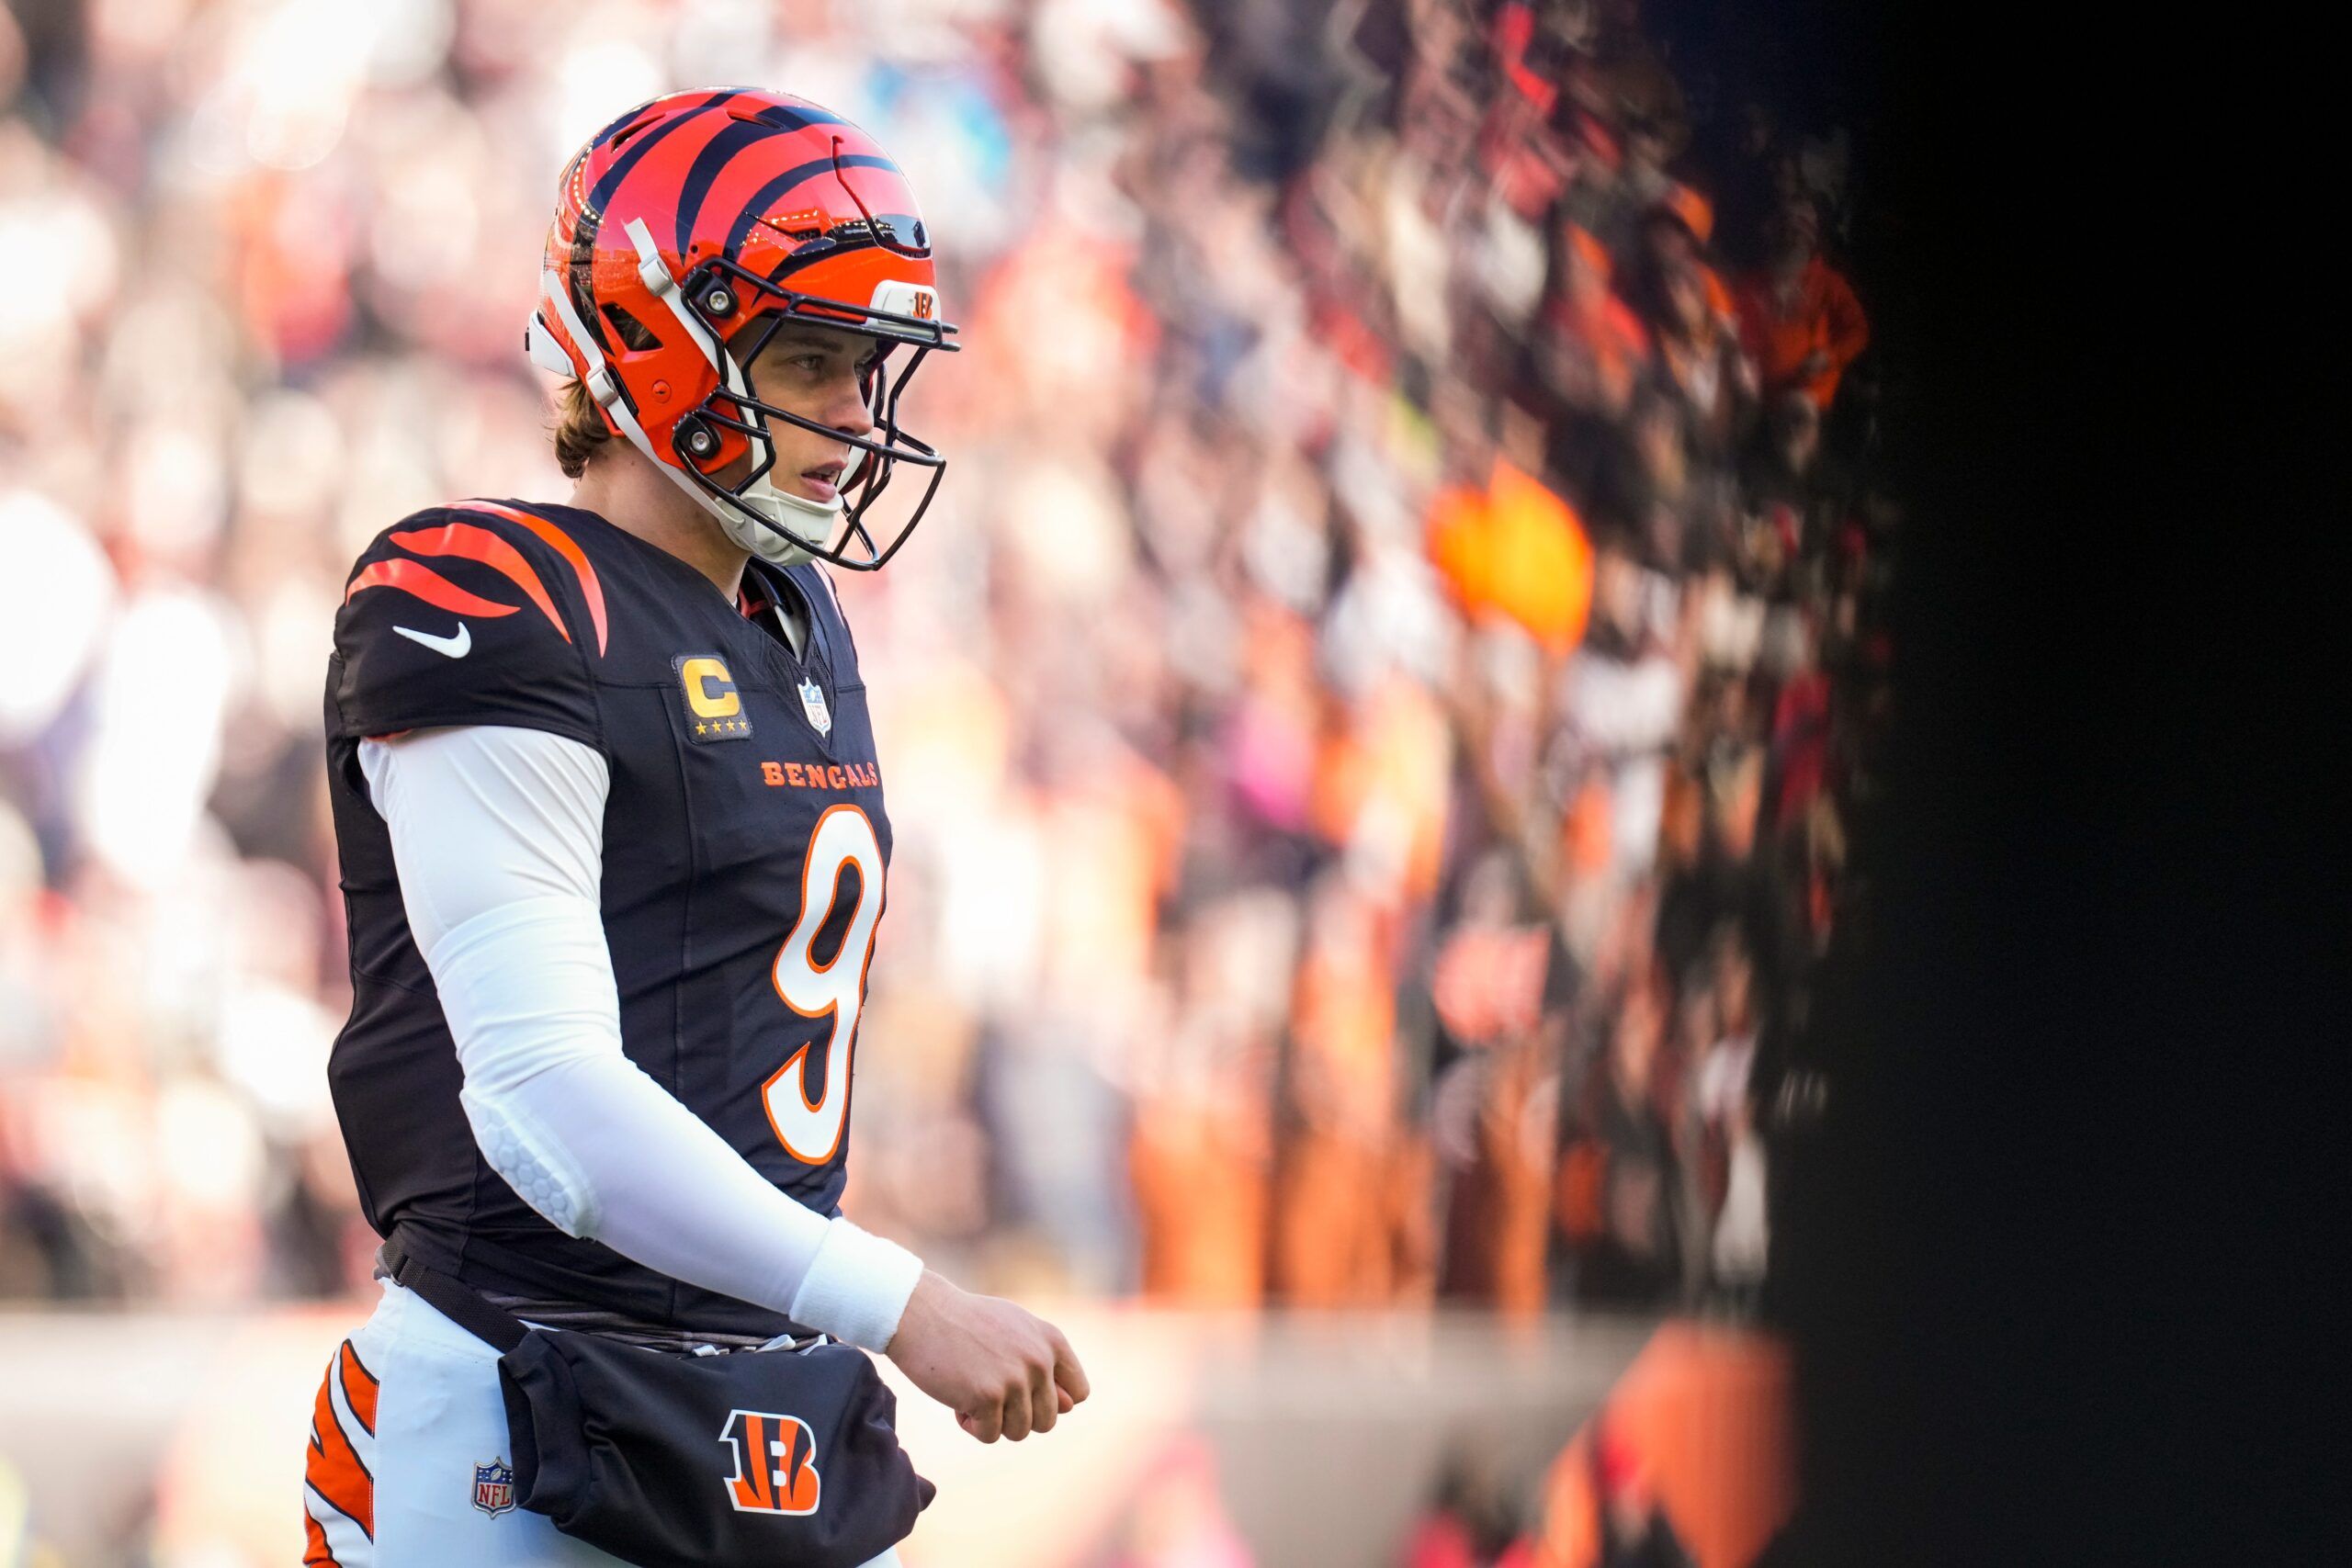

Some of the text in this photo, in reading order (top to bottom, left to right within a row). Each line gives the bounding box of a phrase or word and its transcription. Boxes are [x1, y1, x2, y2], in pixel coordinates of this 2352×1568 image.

[683, 658, 741, 717] C
[761, 761, 878, 789] BENGALS
[762, 804, 885, 1165] 9
[718, 1409, 821, 1516] B
[478, 1483, 511, 1507] NFL
